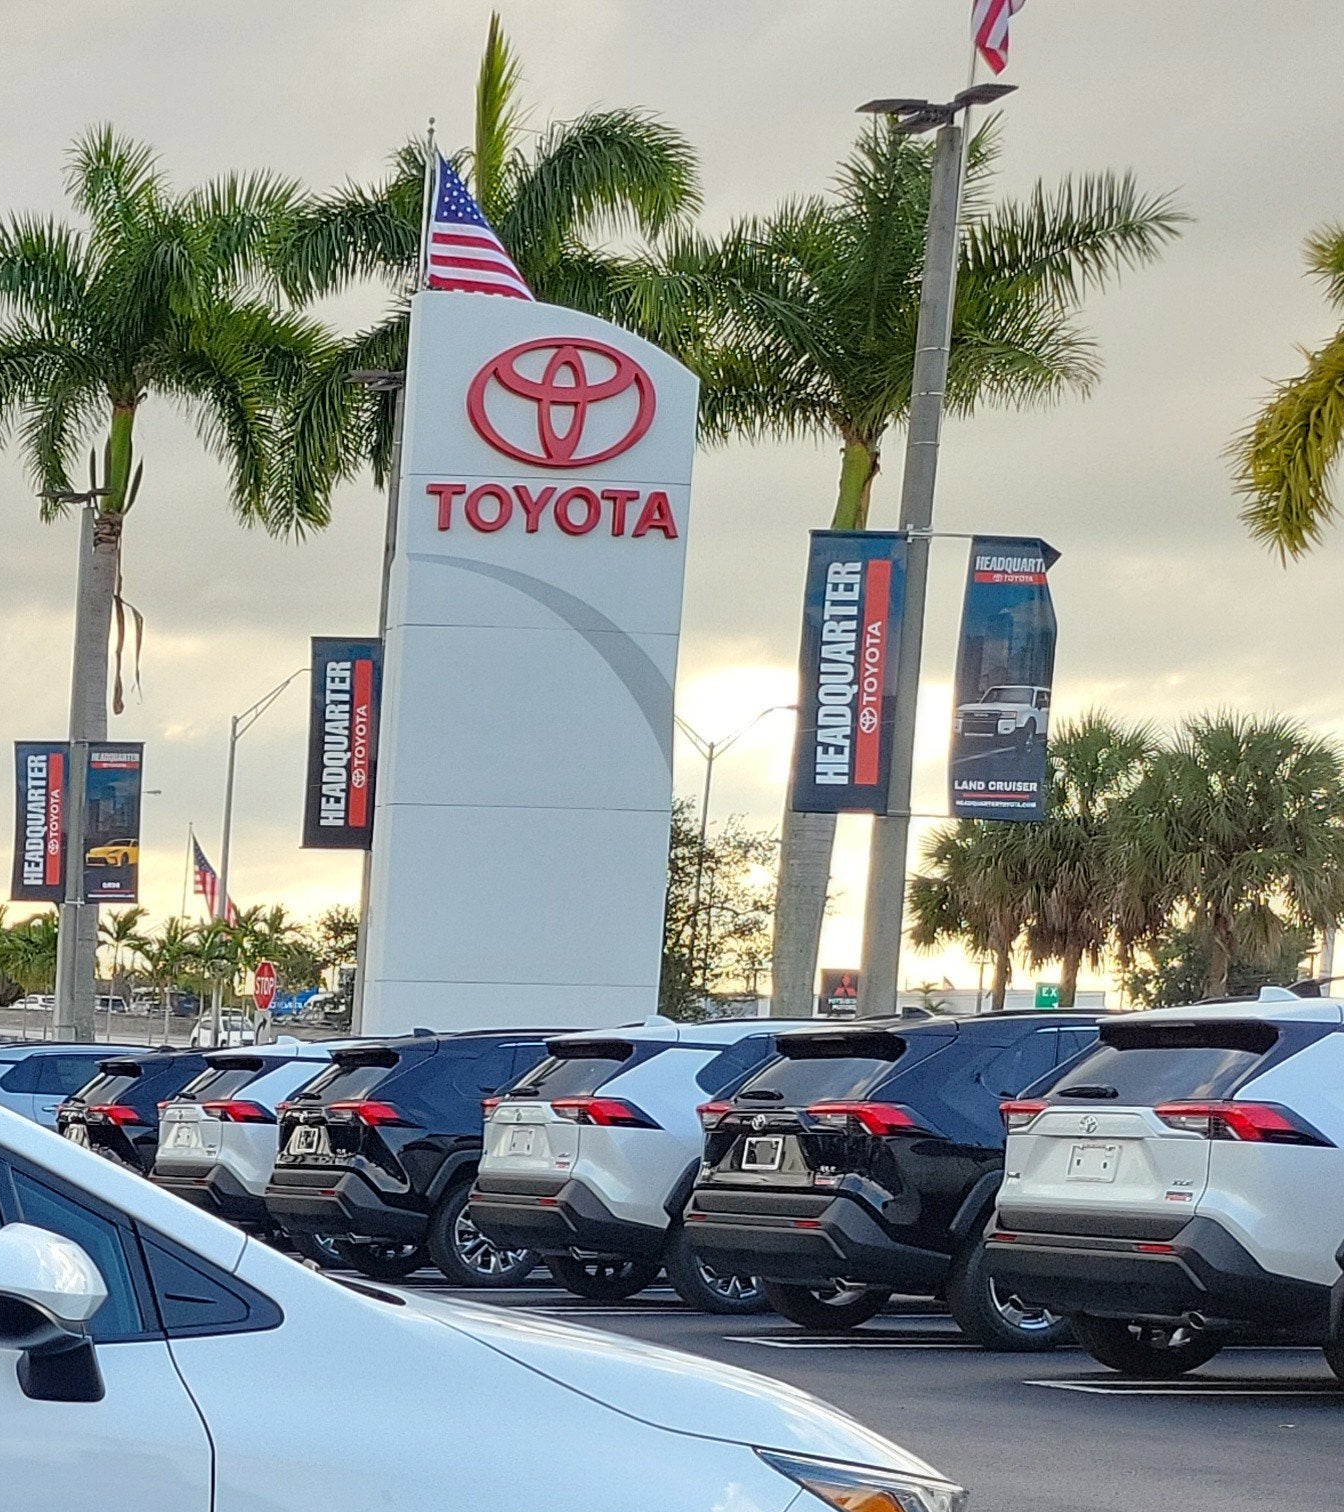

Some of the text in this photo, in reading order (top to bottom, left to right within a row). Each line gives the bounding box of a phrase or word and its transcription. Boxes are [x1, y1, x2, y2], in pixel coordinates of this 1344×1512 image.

[426, 483, 679, 539] TOYOTA
[1004, 574, 1033, 582] TOYOTA
[815, 561, 862, 785] HEADQUARTER
[863, 621, 882, 705] TOYOTA
[320, 661, 351, 827] HEADQUARTER
[353, 705, 367, 767] TOYOTA
[49, 789, 60, 839] TOYOTA
[954, 780, 1038, 792] LAND CRUISER
[23, 754, 47, 886] HEADQUARTER
[255, 976, 274, 996] STOP
